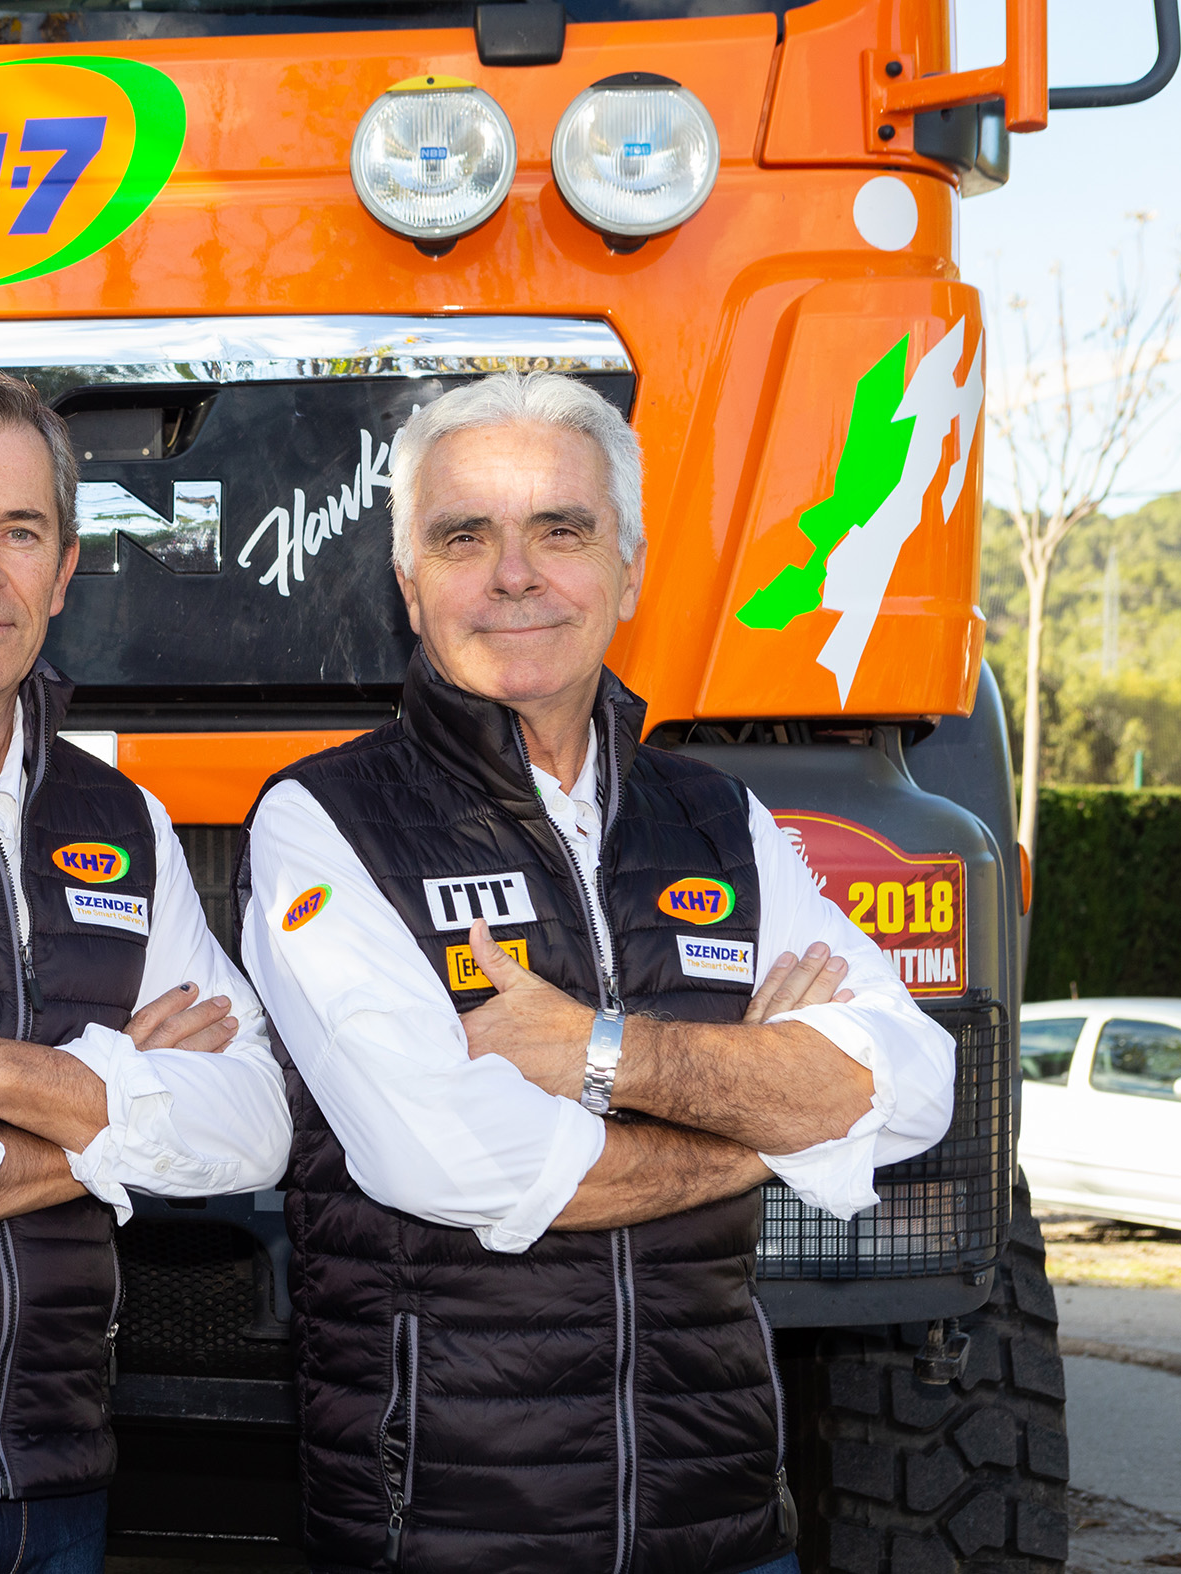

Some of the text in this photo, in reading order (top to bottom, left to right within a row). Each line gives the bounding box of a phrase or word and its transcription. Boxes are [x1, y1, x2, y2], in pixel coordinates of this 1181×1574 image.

[237, 404, 421, 597] Hawk
[74, 894, 143, 917] SZENDEX
[76, 907, 92, 915] The
[93, 909, 117, 919] Smart
[848, 880, 954, 934] 2018
[685, 943, 749, 964] SZENDEX
[881, 948, 957, 984] NTINA
